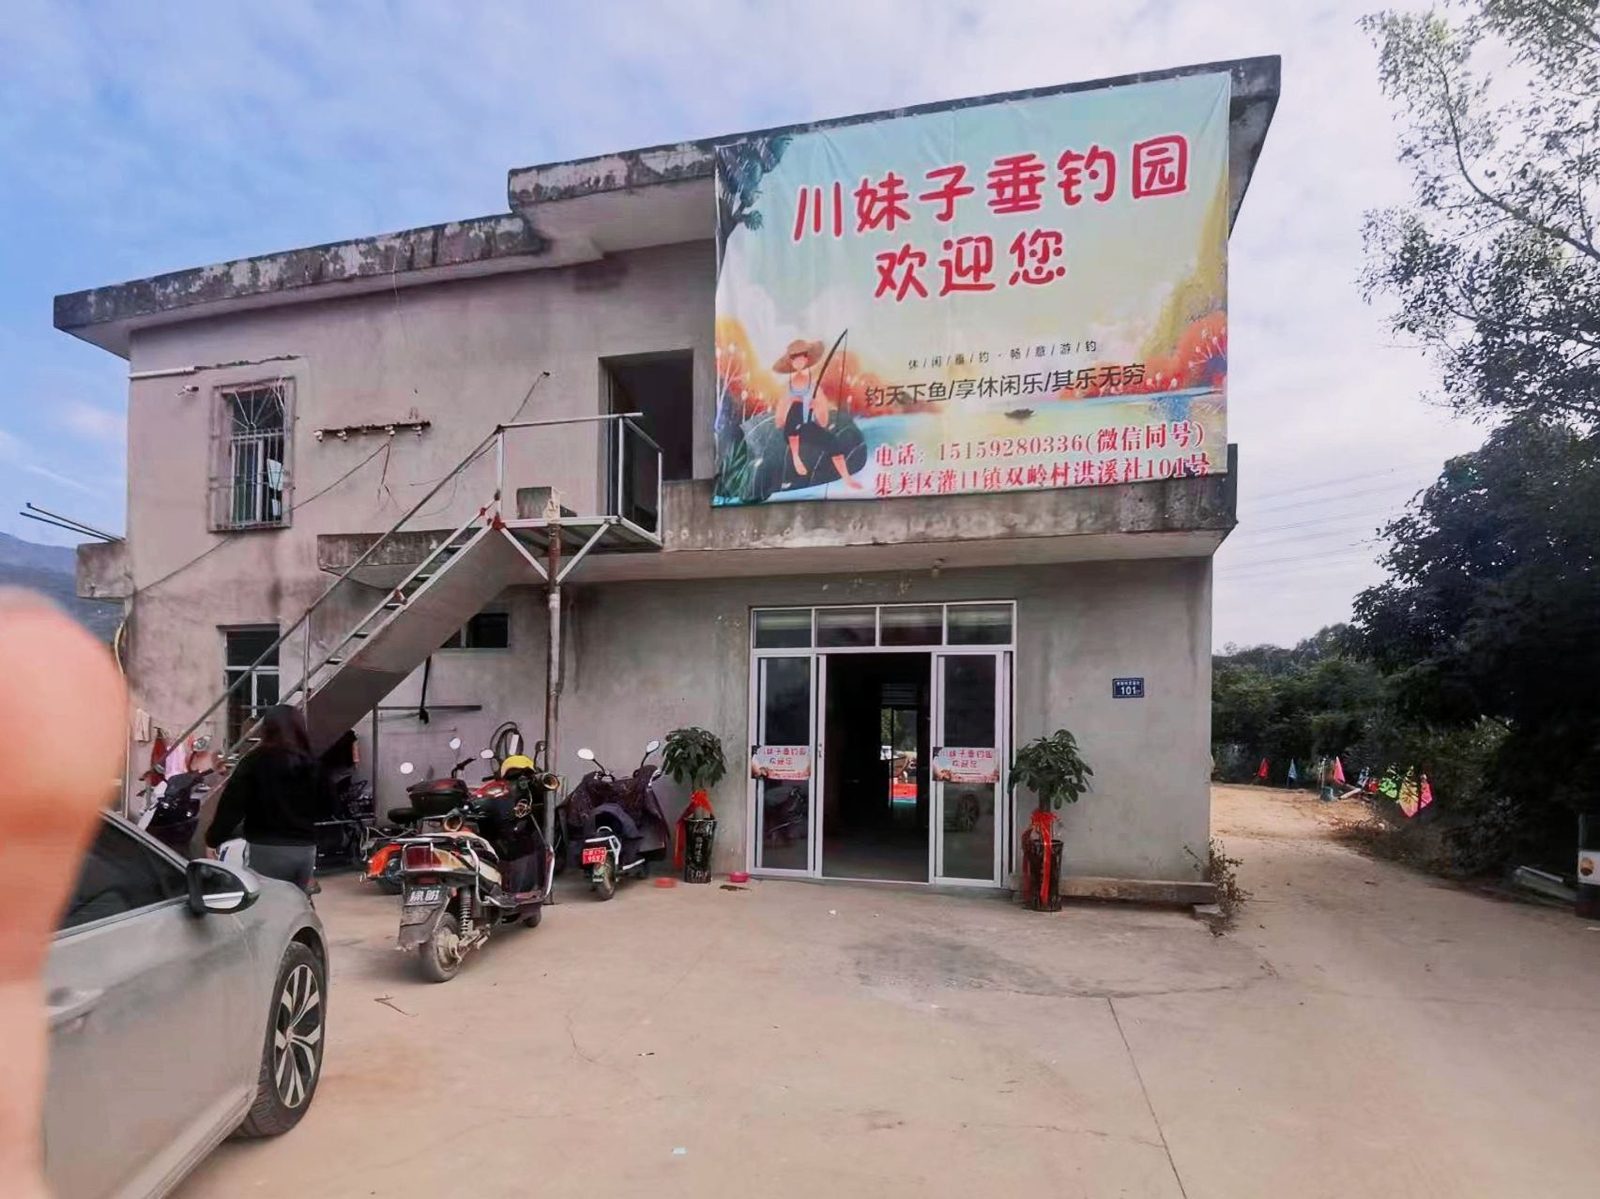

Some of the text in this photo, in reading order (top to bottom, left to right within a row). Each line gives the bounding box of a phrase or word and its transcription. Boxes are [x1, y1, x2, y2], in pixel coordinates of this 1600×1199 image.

[793, 134, 1189, 241] 川妹子垂钓园
[874, 229, 1066, 302] 欢迎您
[865, 363, 1146, 408] 钓天下鱼/享休闲乐/其乐无穷
[874, 452, 1211, 497] 集美区灌口镇双岭村洪溪社101号
[1121, 686, 1136, 695] 101
